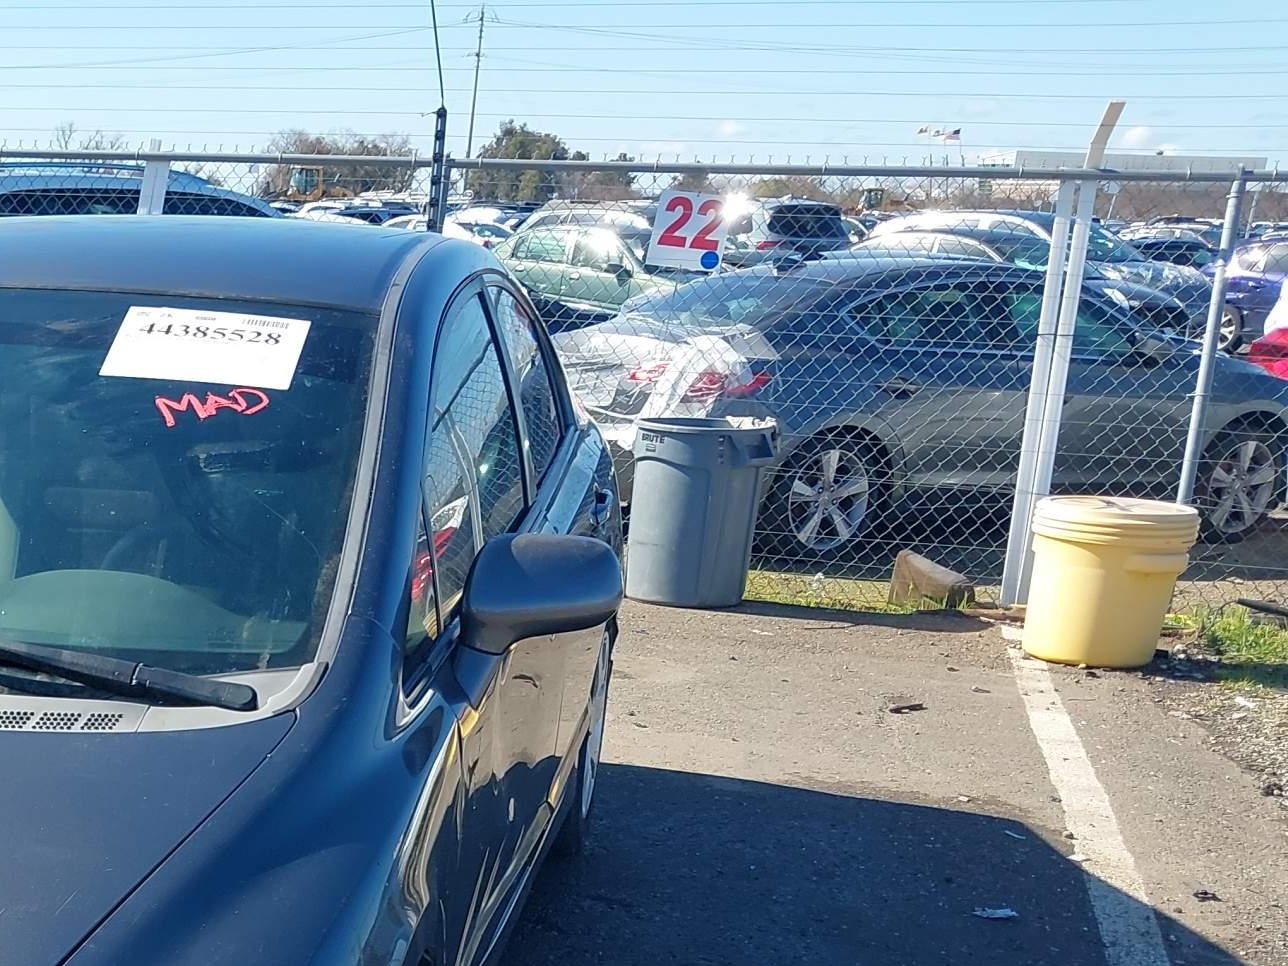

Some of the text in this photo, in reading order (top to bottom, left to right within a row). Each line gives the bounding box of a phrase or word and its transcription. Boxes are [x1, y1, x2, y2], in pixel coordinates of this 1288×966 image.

[657, 196, 724, 251] 22
[138, 322, 283, 346] 44385528
[154, 387, 270, 428] MAD
[641, 432, 665, 444] BRUTE
